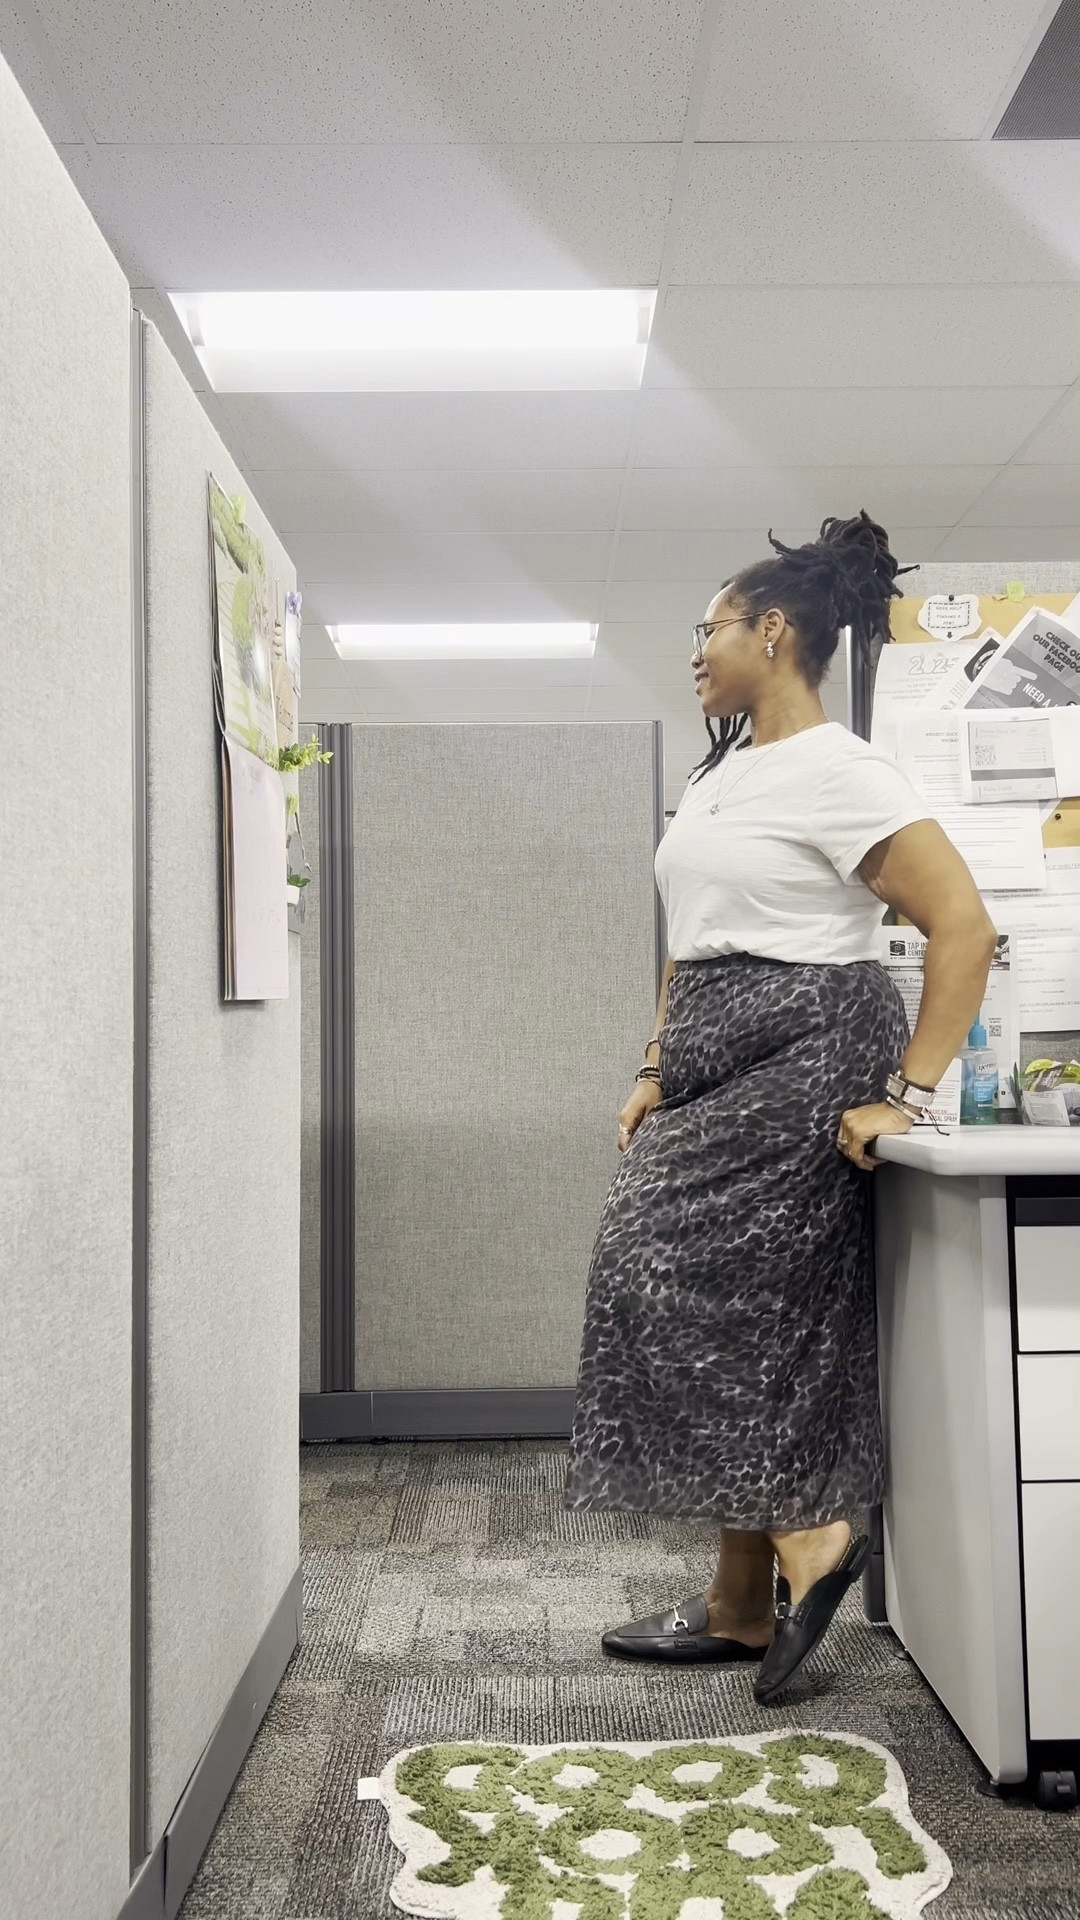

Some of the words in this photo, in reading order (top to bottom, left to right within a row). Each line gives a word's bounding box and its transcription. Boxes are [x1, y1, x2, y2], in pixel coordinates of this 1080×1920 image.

[1033, 634, 1050, 649] OUR
[1045, 631, 1071, 652] CHECK
[1043, 653, 1065, 672] PAGE
[1022, 682, 1045, 702] NEED
[1042, 698, 1051, 708] A
[907, 942, 919, 950] TAP
